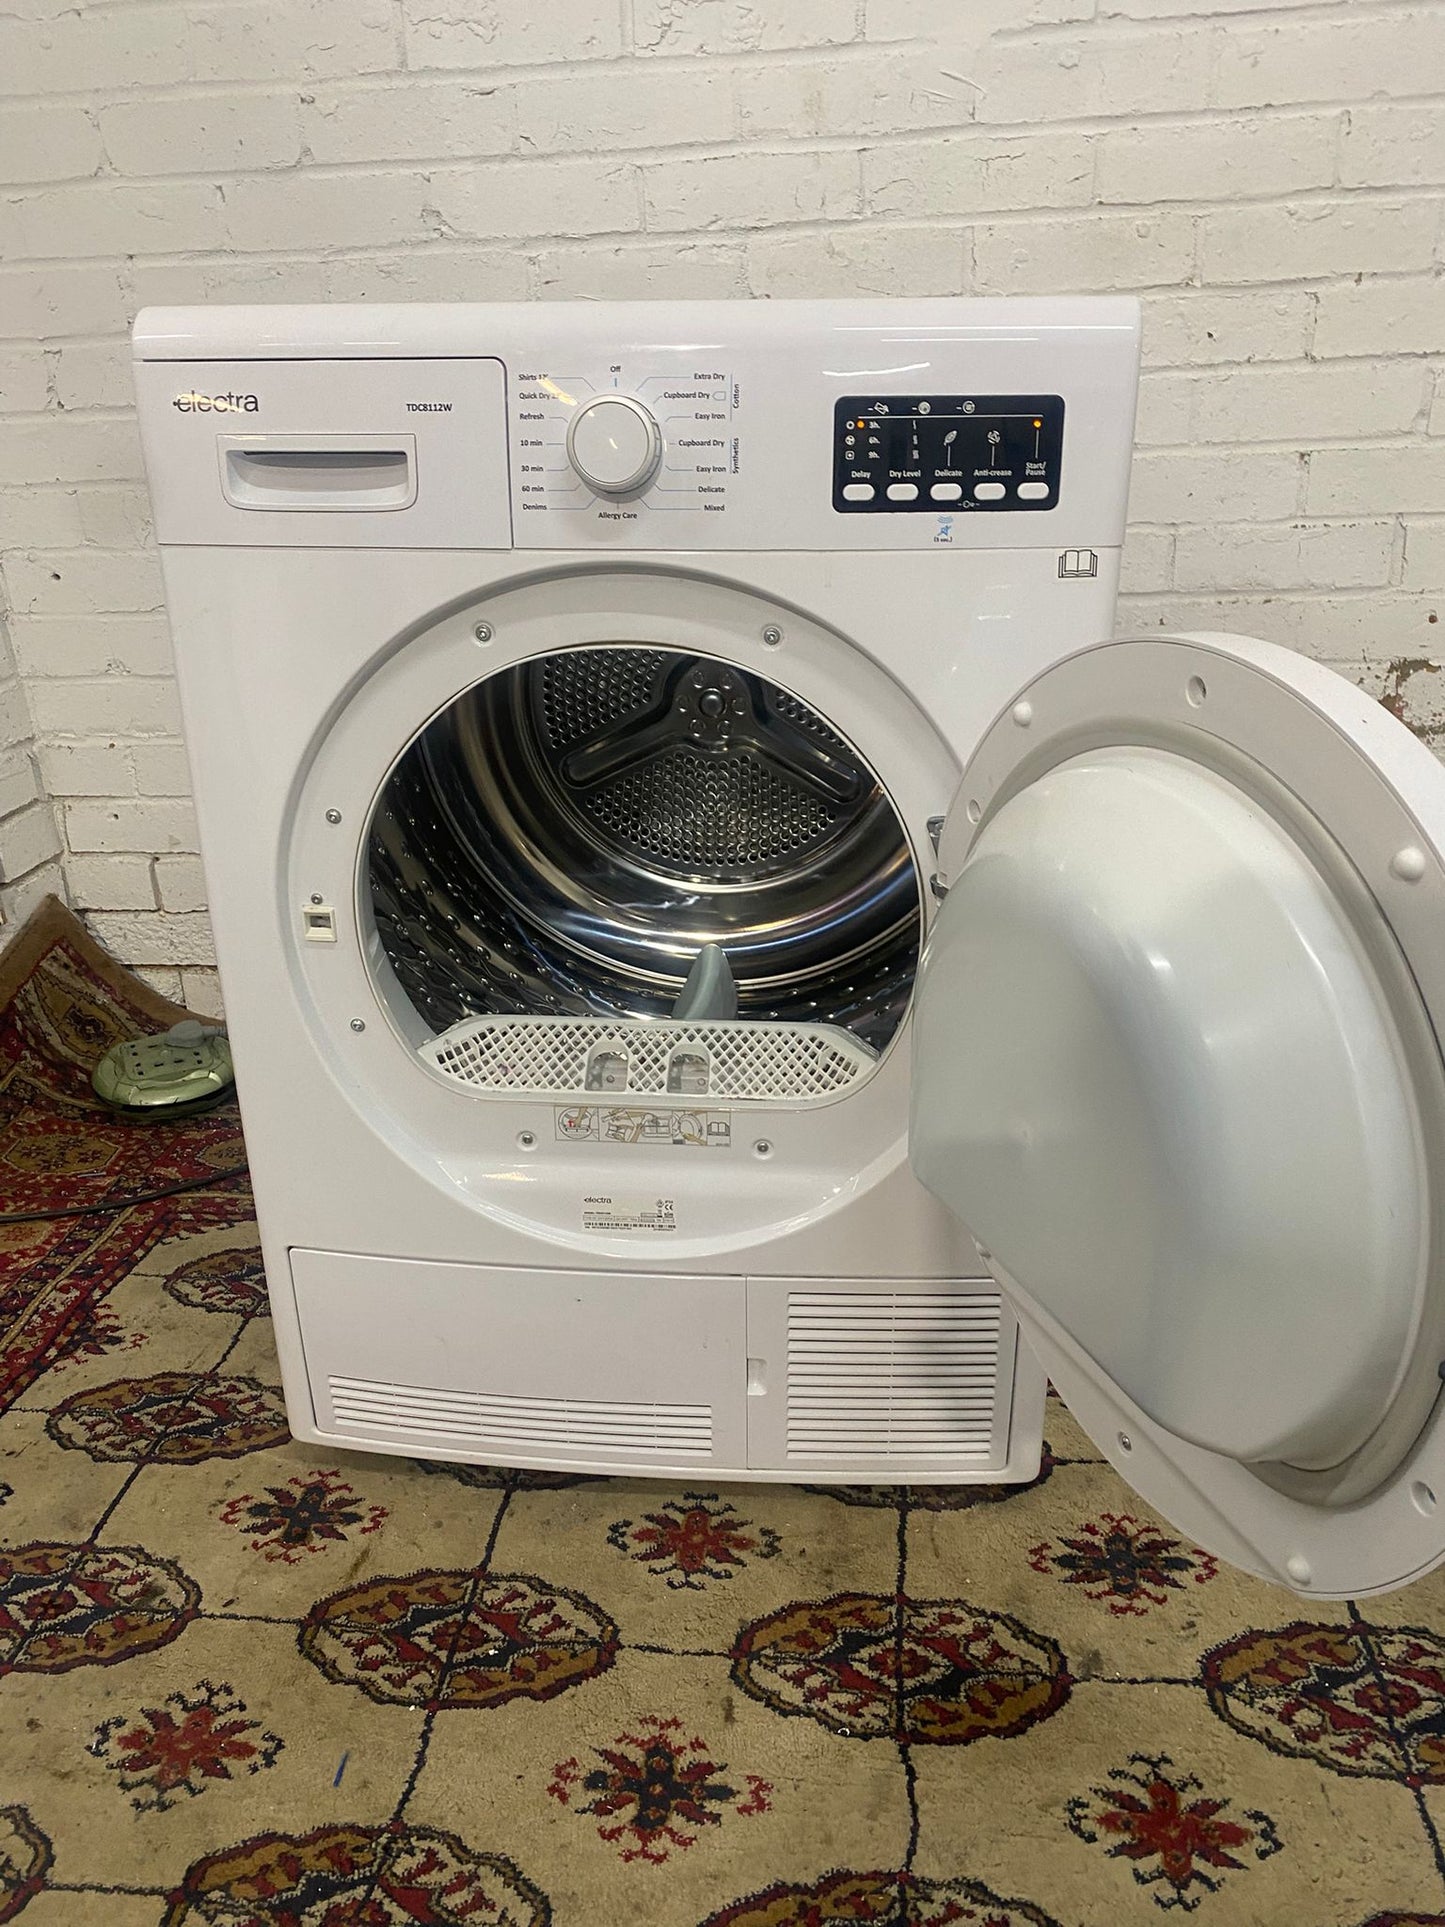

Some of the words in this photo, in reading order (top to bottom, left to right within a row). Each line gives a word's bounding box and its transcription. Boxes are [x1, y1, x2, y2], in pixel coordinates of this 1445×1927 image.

[172, 390, 259, 413] electra
[406, 402, 452, 412] TDC8112W
[851, 470, 872, 478] Delay
[889, 470, 902, 478] Dry
